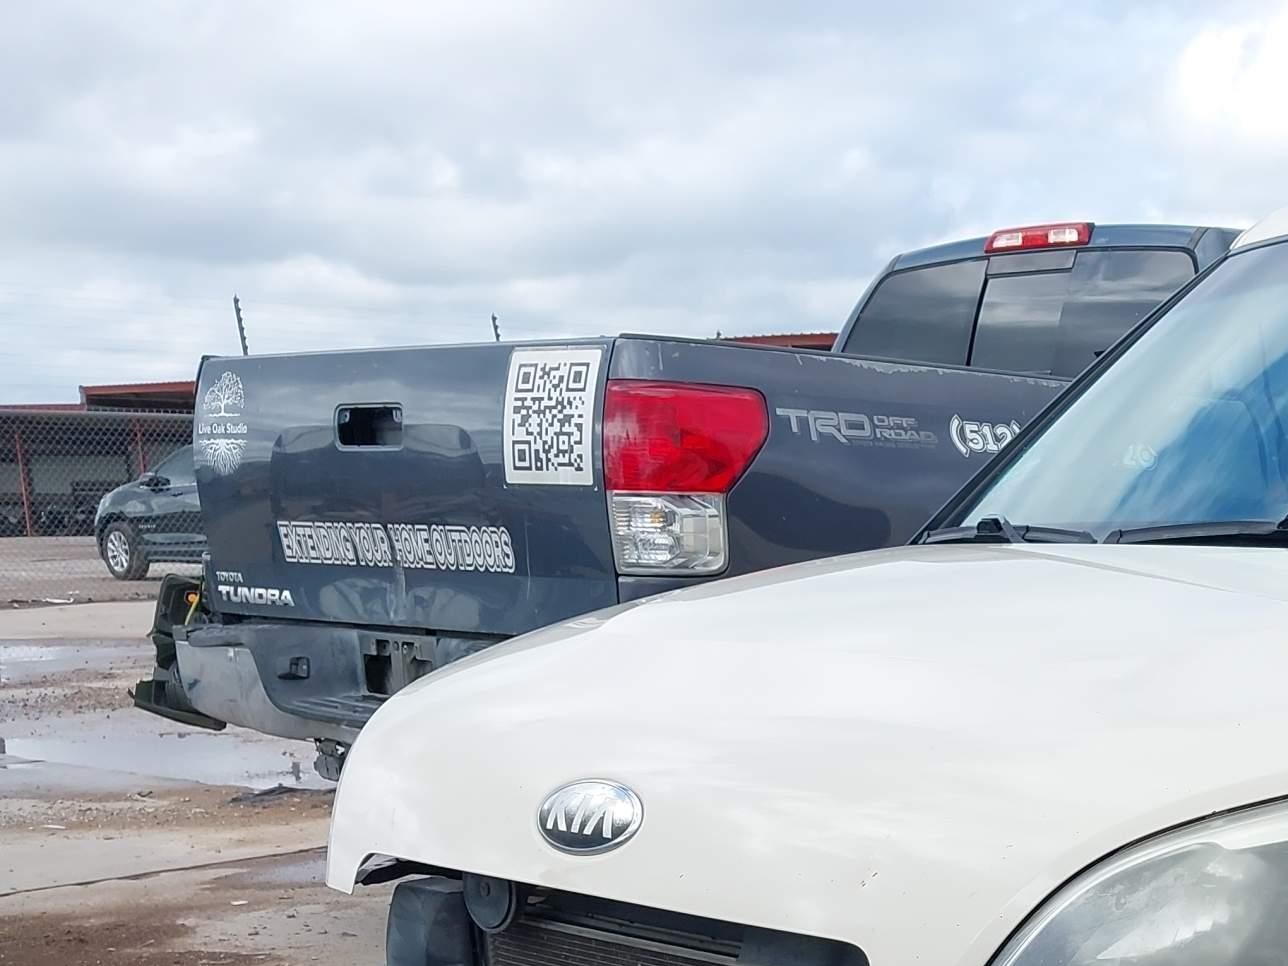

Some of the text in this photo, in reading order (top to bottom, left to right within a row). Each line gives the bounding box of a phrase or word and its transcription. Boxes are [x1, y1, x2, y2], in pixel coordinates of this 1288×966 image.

[198, 422, 248, 434] Live Oak Studio
[776, 407, 873, 444] TRD
[873, 415, 917, 428] OFF
[875, 428, 936, 441] ROAD
[277, 521, 516, 573] EXTENDING YOUR HOME OUTDOORS
[215, 571, 244, 583] TOYOTA
[217, 585, 295, 607] TUNDRA
[545, 791, 613, 839] KIA
